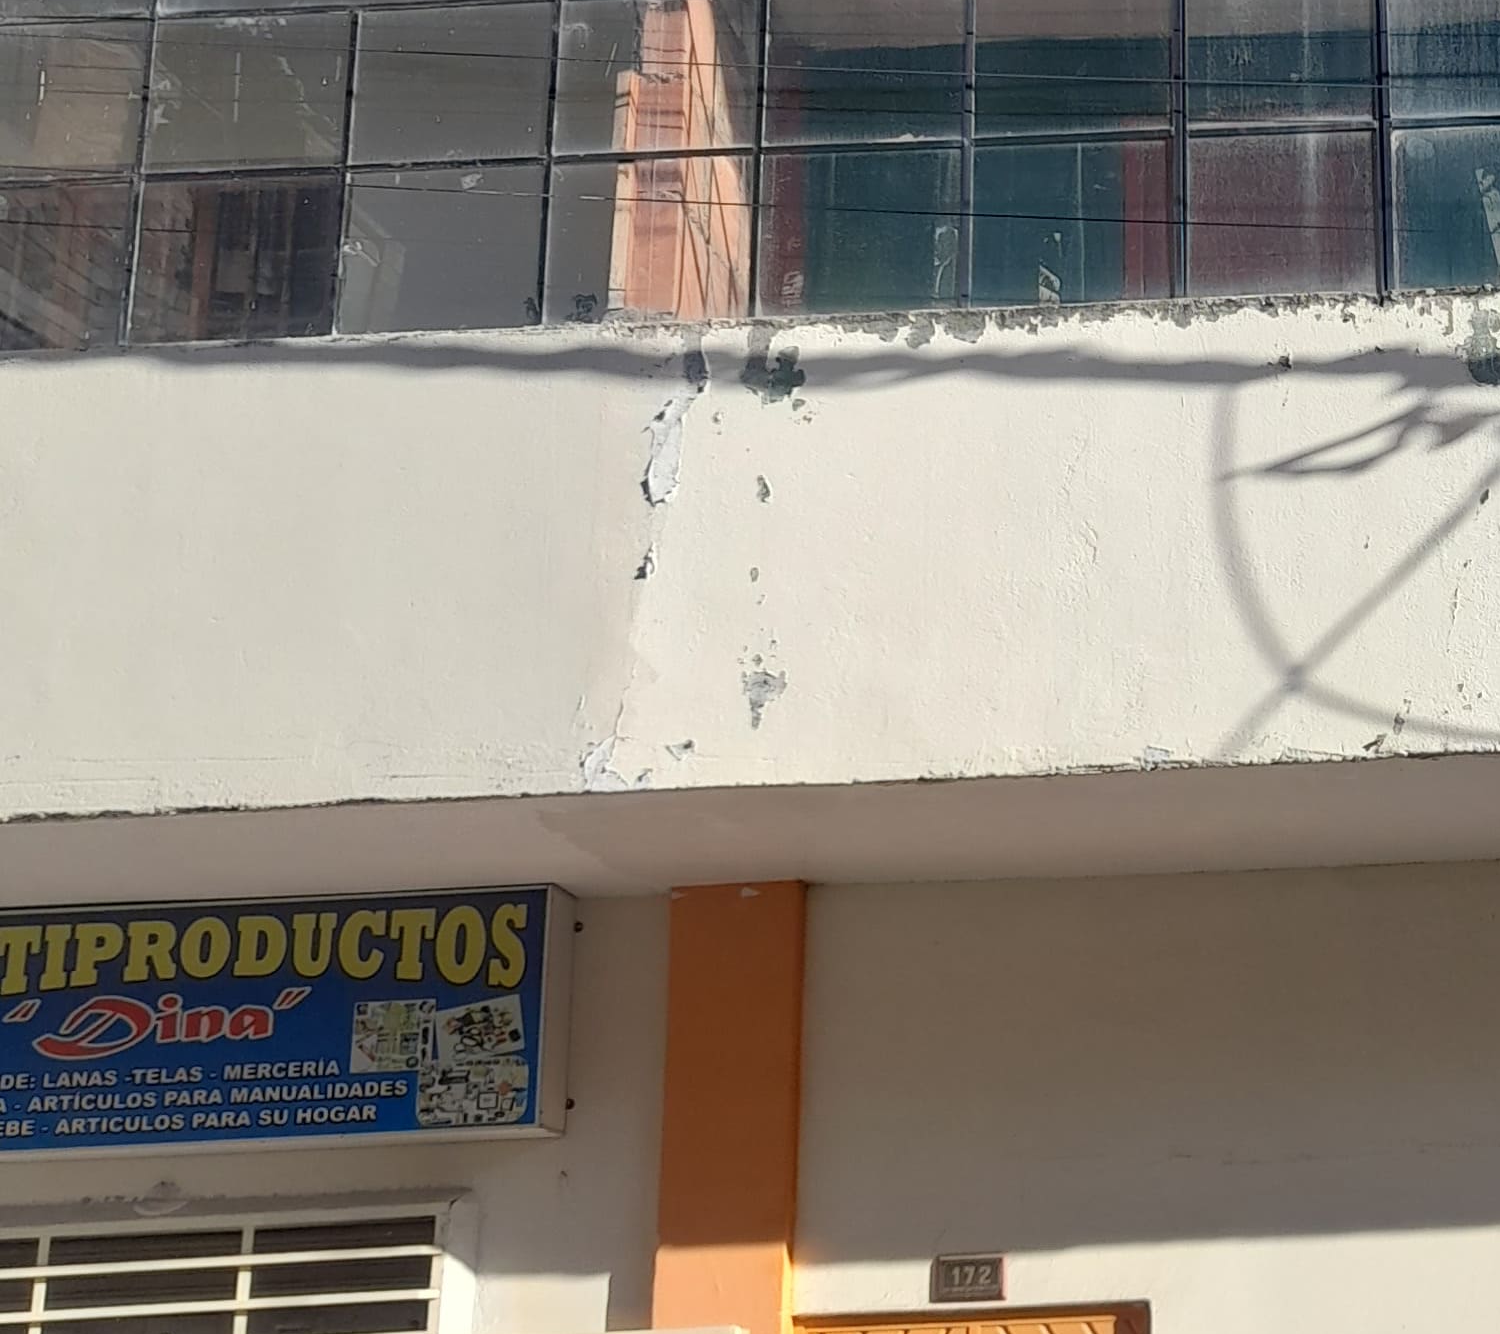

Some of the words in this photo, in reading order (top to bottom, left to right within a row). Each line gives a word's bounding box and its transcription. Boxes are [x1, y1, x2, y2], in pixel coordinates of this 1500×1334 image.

[0, 903, 529, 996] TIPRODUCTOS
[43, 1069, 117, 1088] LANAS
[224, 1057, 340, 1080] MERCERÍA
[27, 1091, 157, 1113] ARTÍCULOS
[163, 1087, 223, 1107] PARA
[230, 1079, 408, 1103] MANUALIDADES
[55, 1113, 185, 1135] ARTICULOS
[192, 1110, 250, 1129] PARA
[258, 1108, 288, 1126] SU
[296, 1104, 377, 1124] HOGAR
[951, 1265, 992, 1285] 172
